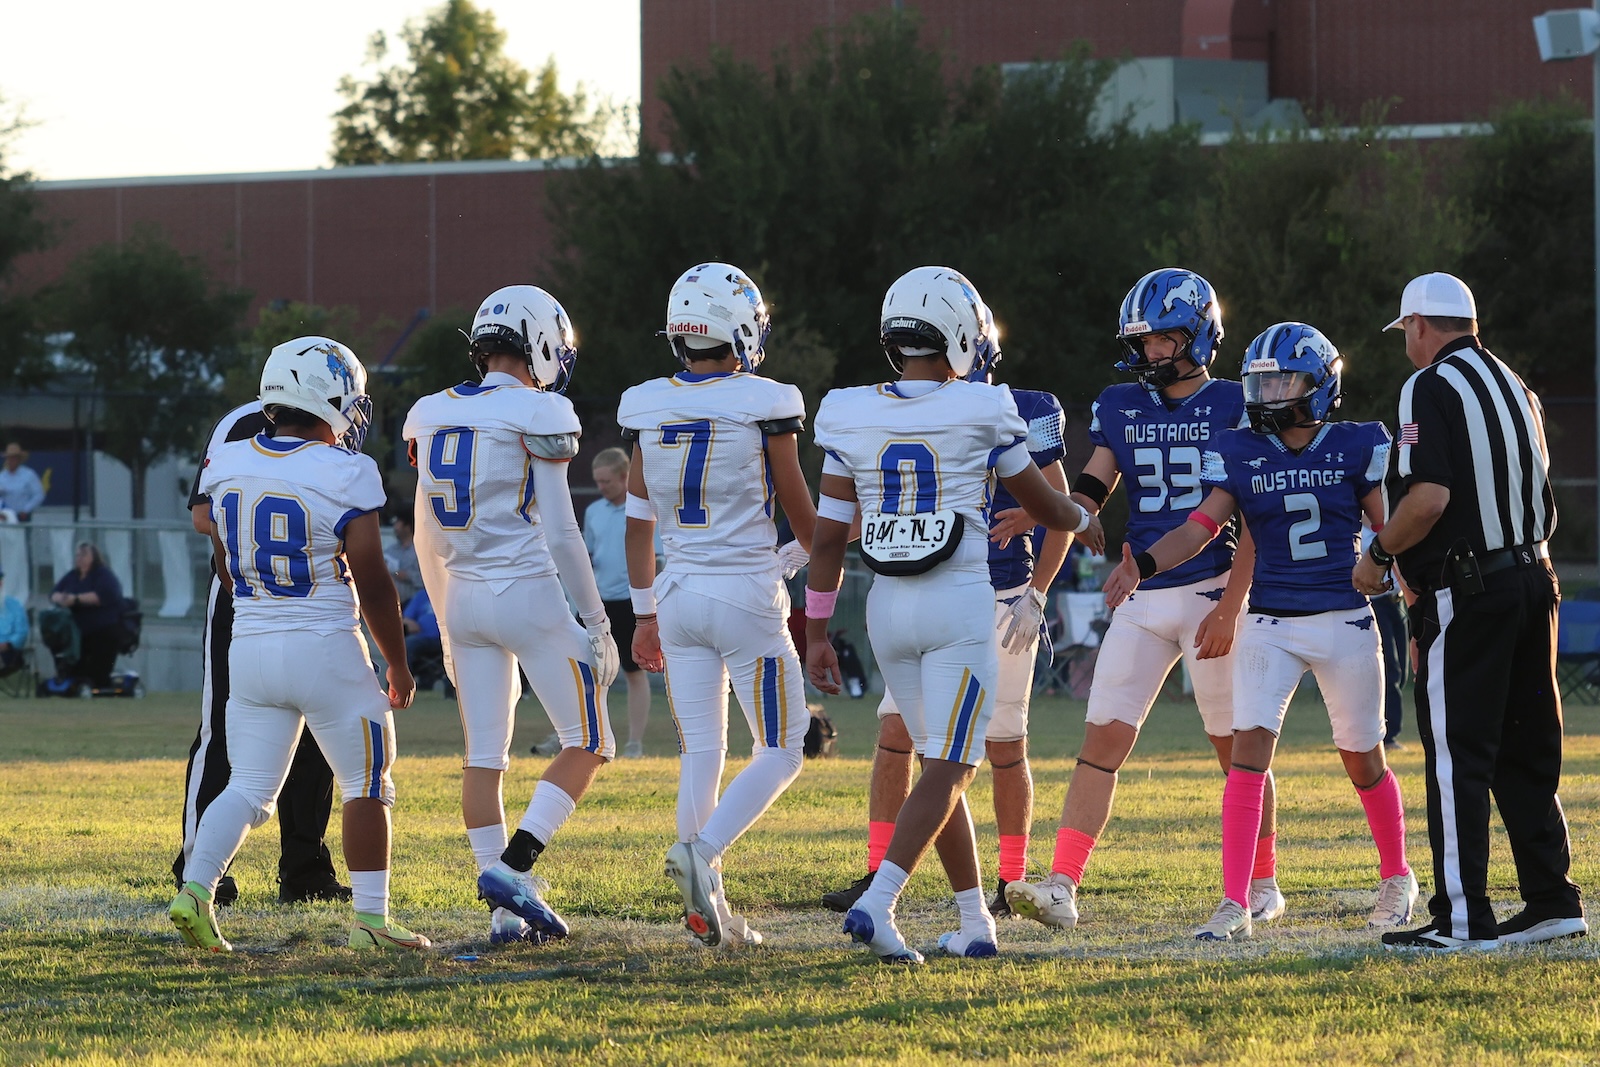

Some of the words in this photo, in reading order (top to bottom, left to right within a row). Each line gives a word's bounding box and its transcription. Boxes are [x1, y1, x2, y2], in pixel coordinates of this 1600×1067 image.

[477, 325, 500, 336] schutt
[668, 322, 708, 335] Riddell
[890, 318, 917, 329] schutt
[1125, 324, 1147, 333] Riddell
[1250, 361, 1275, 369] Riddell
[1125, 422, 1210, 444] MUSTANGS
[427, 426, 478, 530] 9
[658, 419, 715, 528] 7
[877, 439, 942, 514] 0
[1133, 446, 1204, 513] 33
[1251, 469, 1345, 494] MUSTANGS
[1283, 492, 1329, 561] 2
[219, 488, 318, 600] 18
